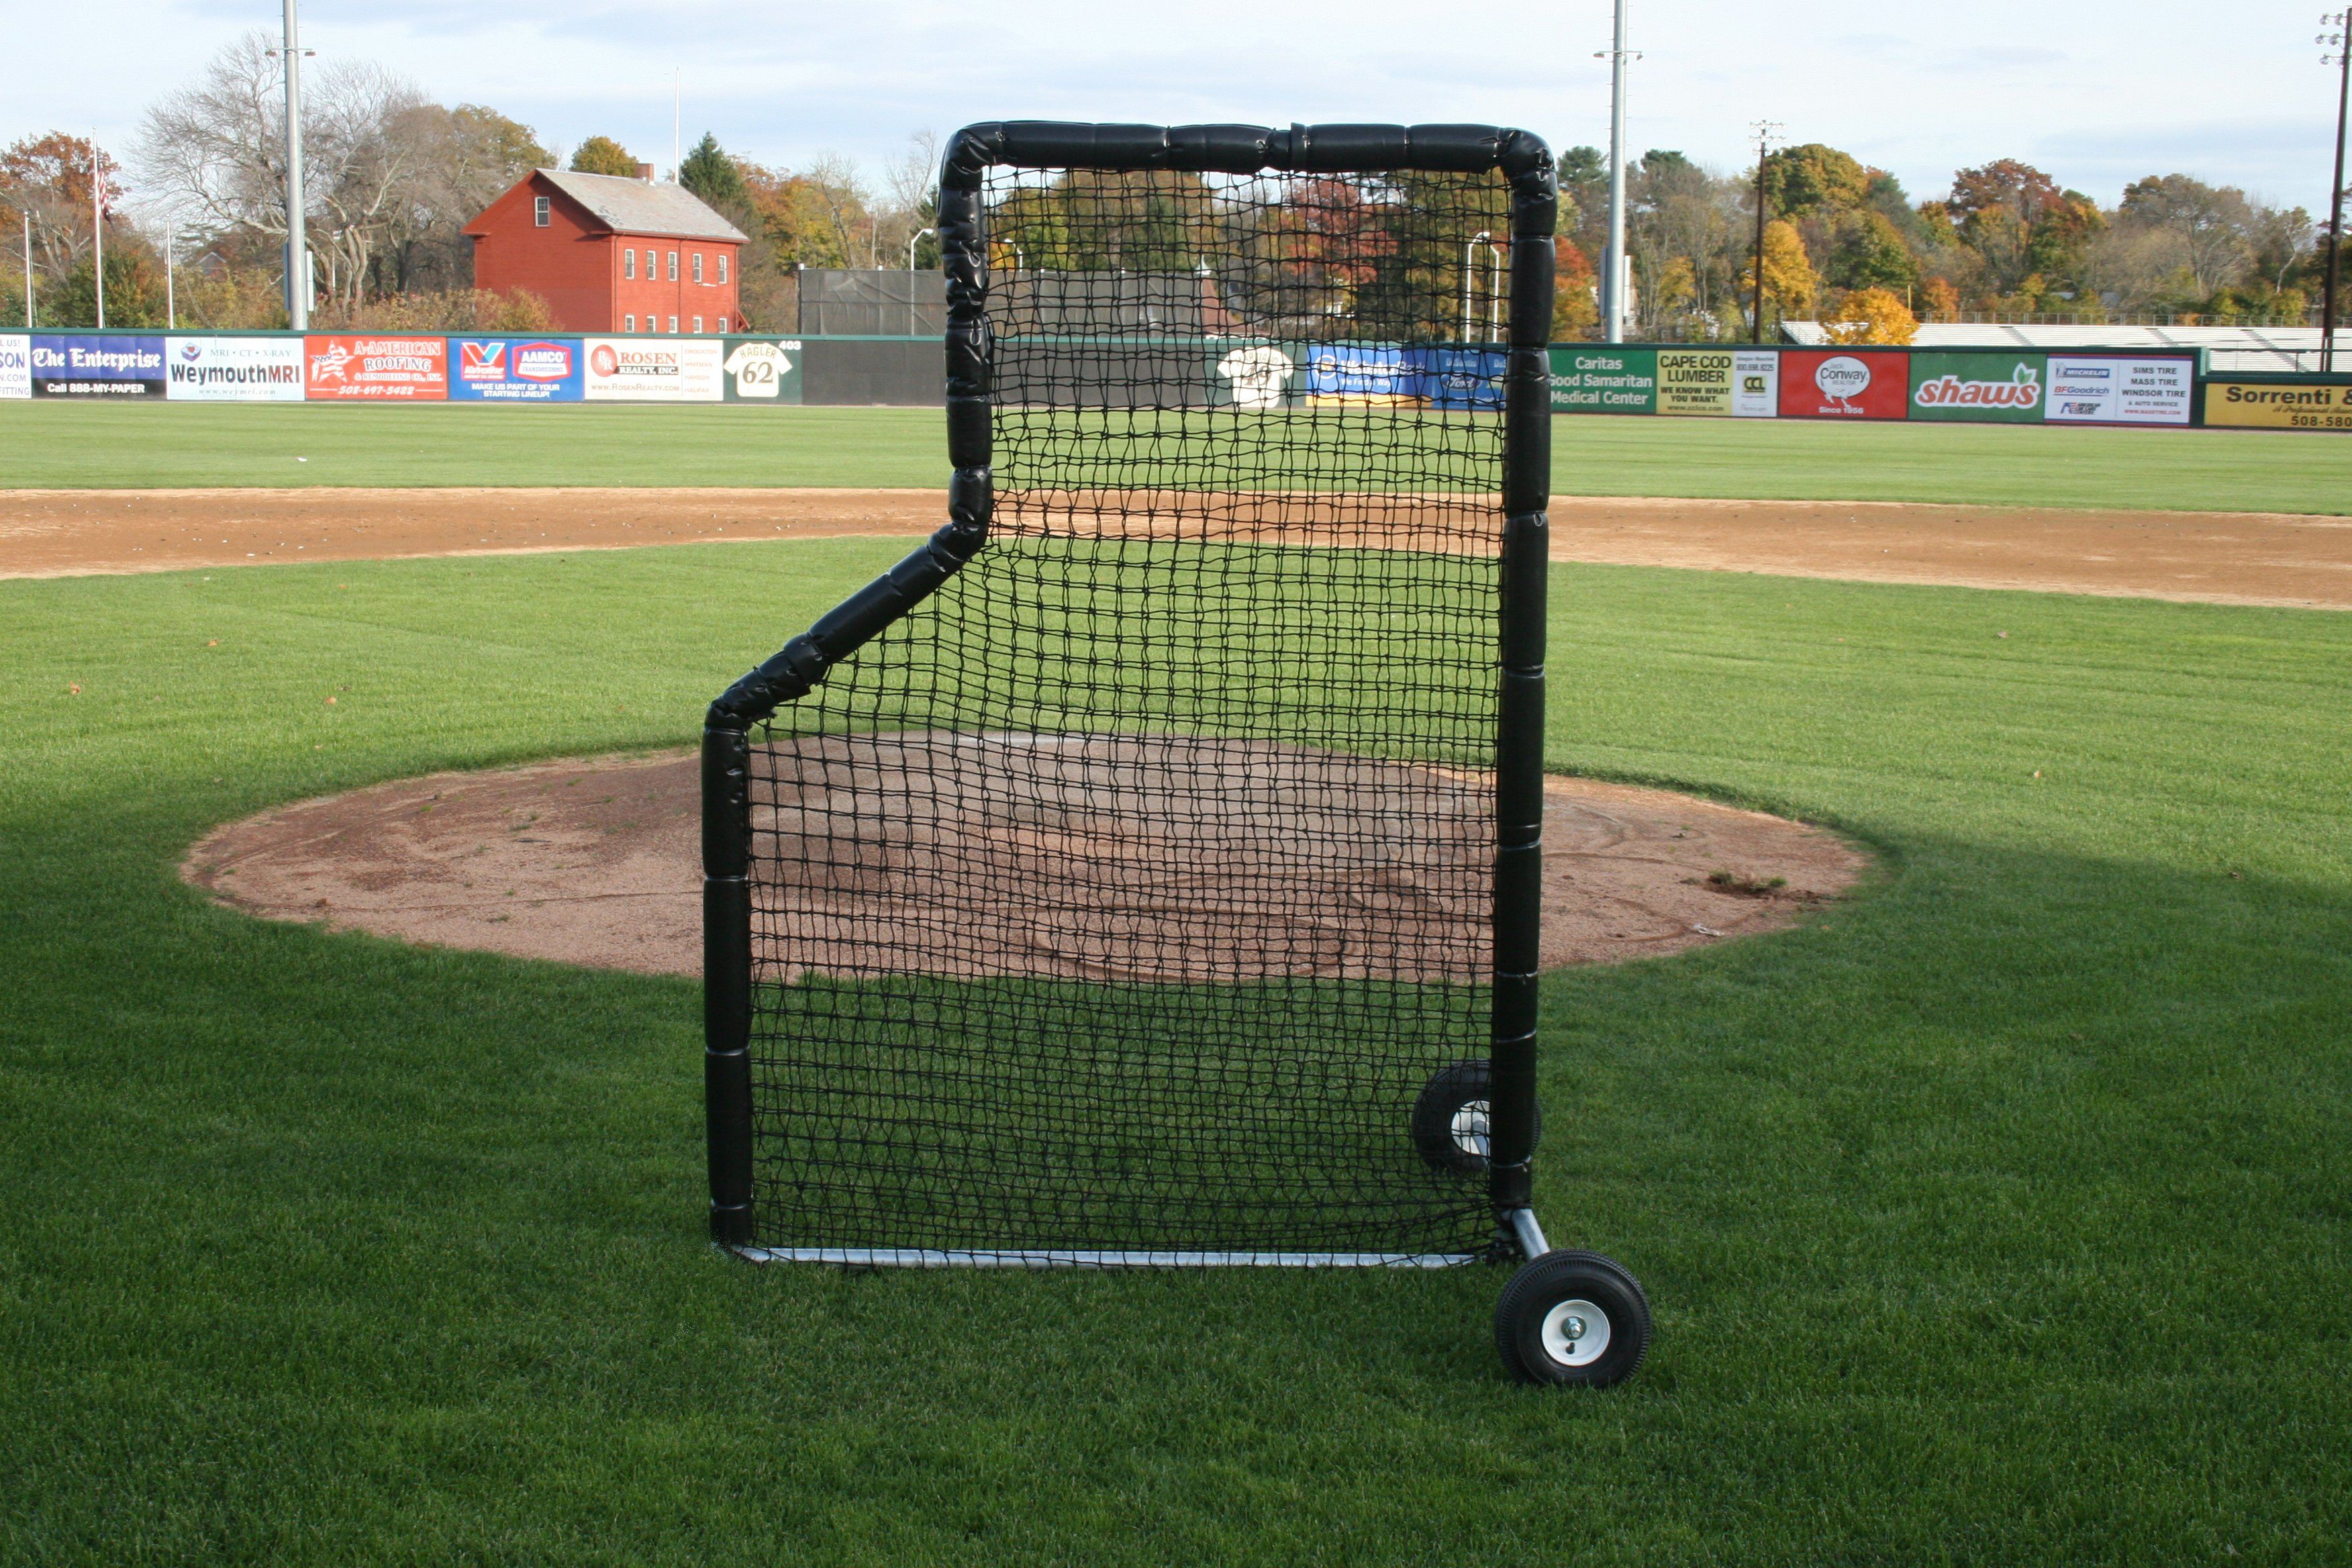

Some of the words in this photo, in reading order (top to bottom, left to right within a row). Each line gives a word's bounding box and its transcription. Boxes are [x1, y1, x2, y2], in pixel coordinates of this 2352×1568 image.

[7, 339, 20, 347] US!
[354, 341, 441, 356] A-AMERICAN
[210, 349, 229, 357] MRI
[240, 349, 252, 357] CT
[521, 350, 565, 363] AAMCO
[620, 352, 677, 364] ROSEN
[739, 346, 777, 359] HAGLER
[32, 348, 66, 367] The
[69, 348, 161, 372] Enterprise
[363, 356, 432, 372] ROOFING
[1575, 356, 1623, 370] Caritas
[1660, 356, 1697, 369] CAPE
[1700, 356, 1732, 369] COD
[170, 364, 300, 386] WeymouthMRI
[361, 373, 410, 381] REMODELING
[619, 366, 656, 375] REALTY,
[743, 361, 773, 383] 62
[1667, 370, 1725, 383] LUMBER
[1583, 374, 1652, 388] Samaritan
[1744, 377, 1765, 390] CCL
[47, 383, 66, 393] Call
[69, 383, 145, 393] 888-MY-PAPER
[2054, 386, 2109, 394] BFGoodrich
[1551, 391, 1600, 403] Medical
[1603, 391, 1648, 405] Center
[2226, 386, 2331, 405] Sorrenti
